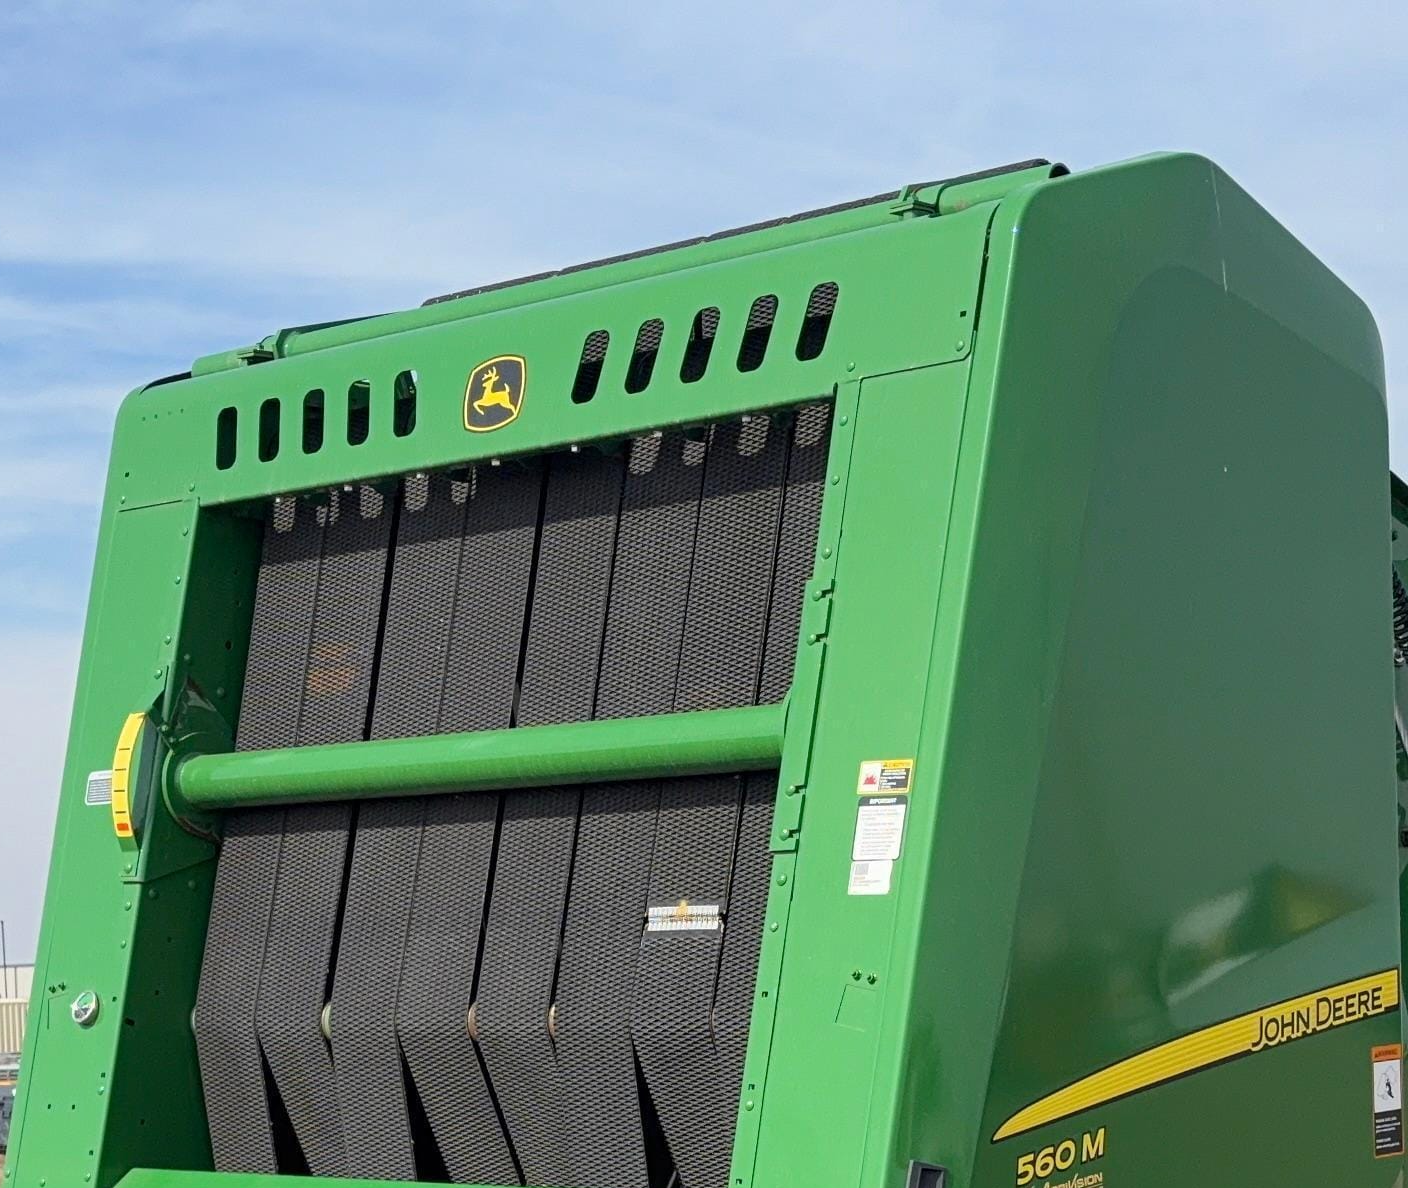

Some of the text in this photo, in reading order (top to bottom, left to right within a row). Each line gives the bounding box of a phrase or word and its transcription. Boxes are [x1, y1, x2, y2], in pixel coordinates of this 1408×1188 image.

[1251, 986, 1383, 1049] JOHN DEERE
[1016, 1126, 1106, 1186] 560 M
